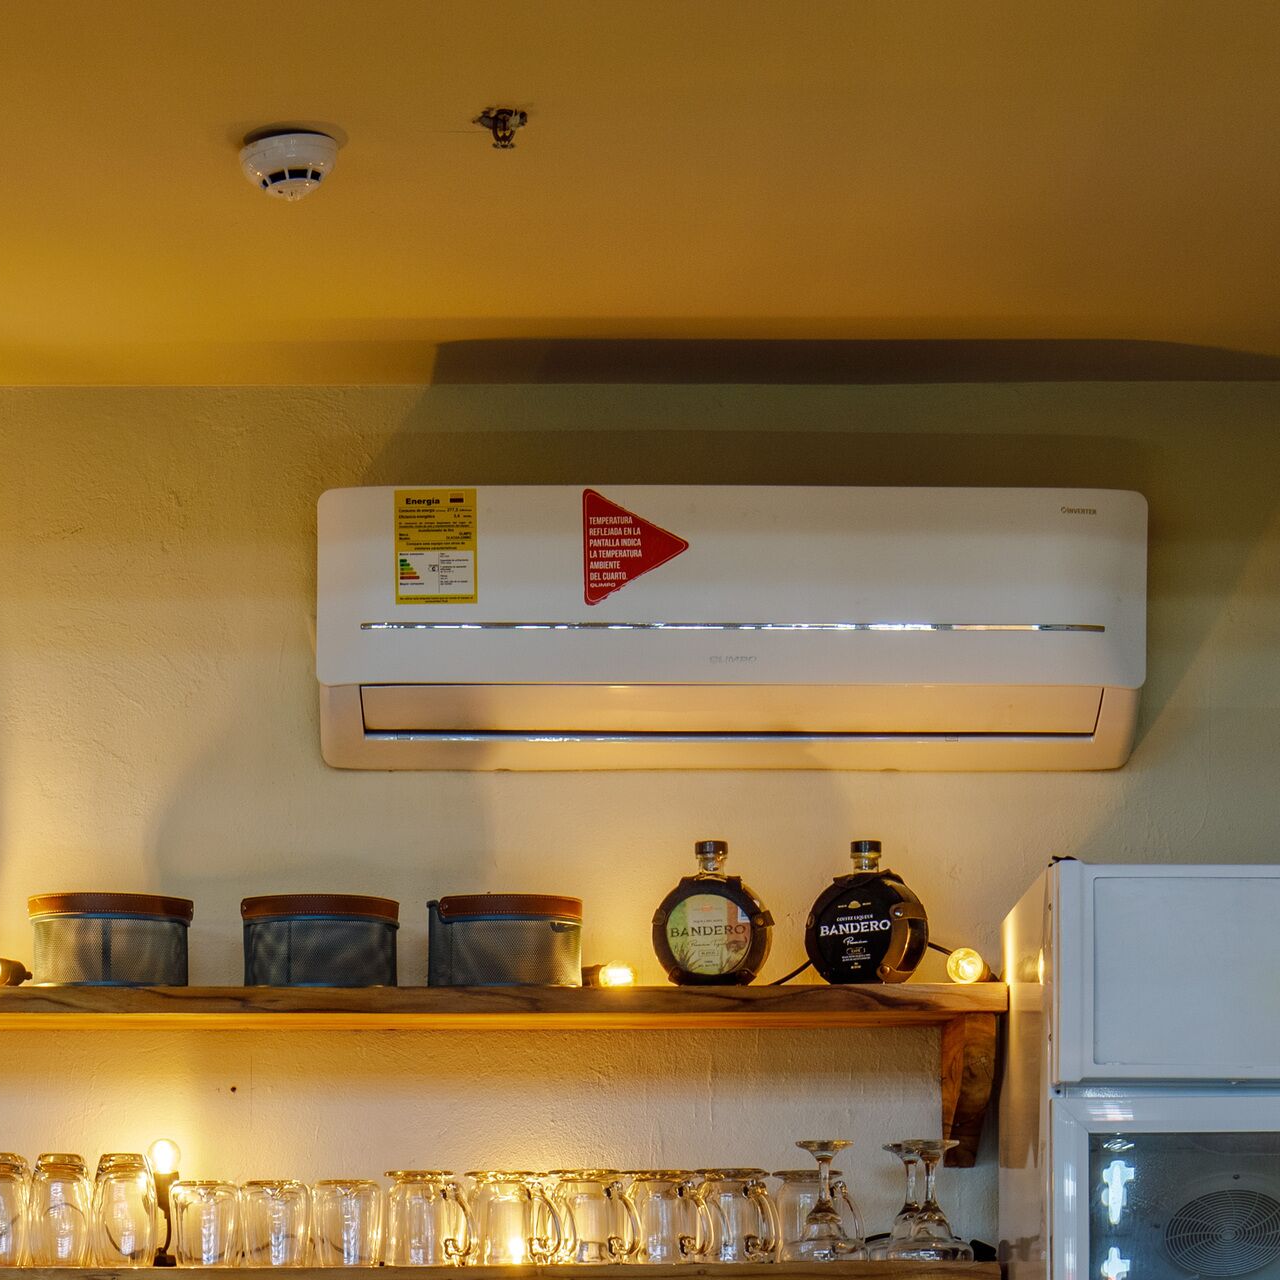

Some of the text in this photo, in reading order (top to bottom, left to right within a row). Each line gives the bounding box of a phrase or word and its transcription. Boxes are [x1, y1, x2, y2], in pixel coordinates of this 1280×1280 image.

[589, 516, 633, 525] TEMPERATURA
[589, 527, 641, 536] REFLEJADA EN LA
[589, 538, 641, 547] PANTALLA INDICA
[590, 549, 642, 558] LA TEMPERATURA
[590, 561, 620, 569] AMBIENTE
[590, 572, 602, 580] DEL
[670, 924, 746, 938] BANDERO
[820, 919, 891, 937] BANDERO
